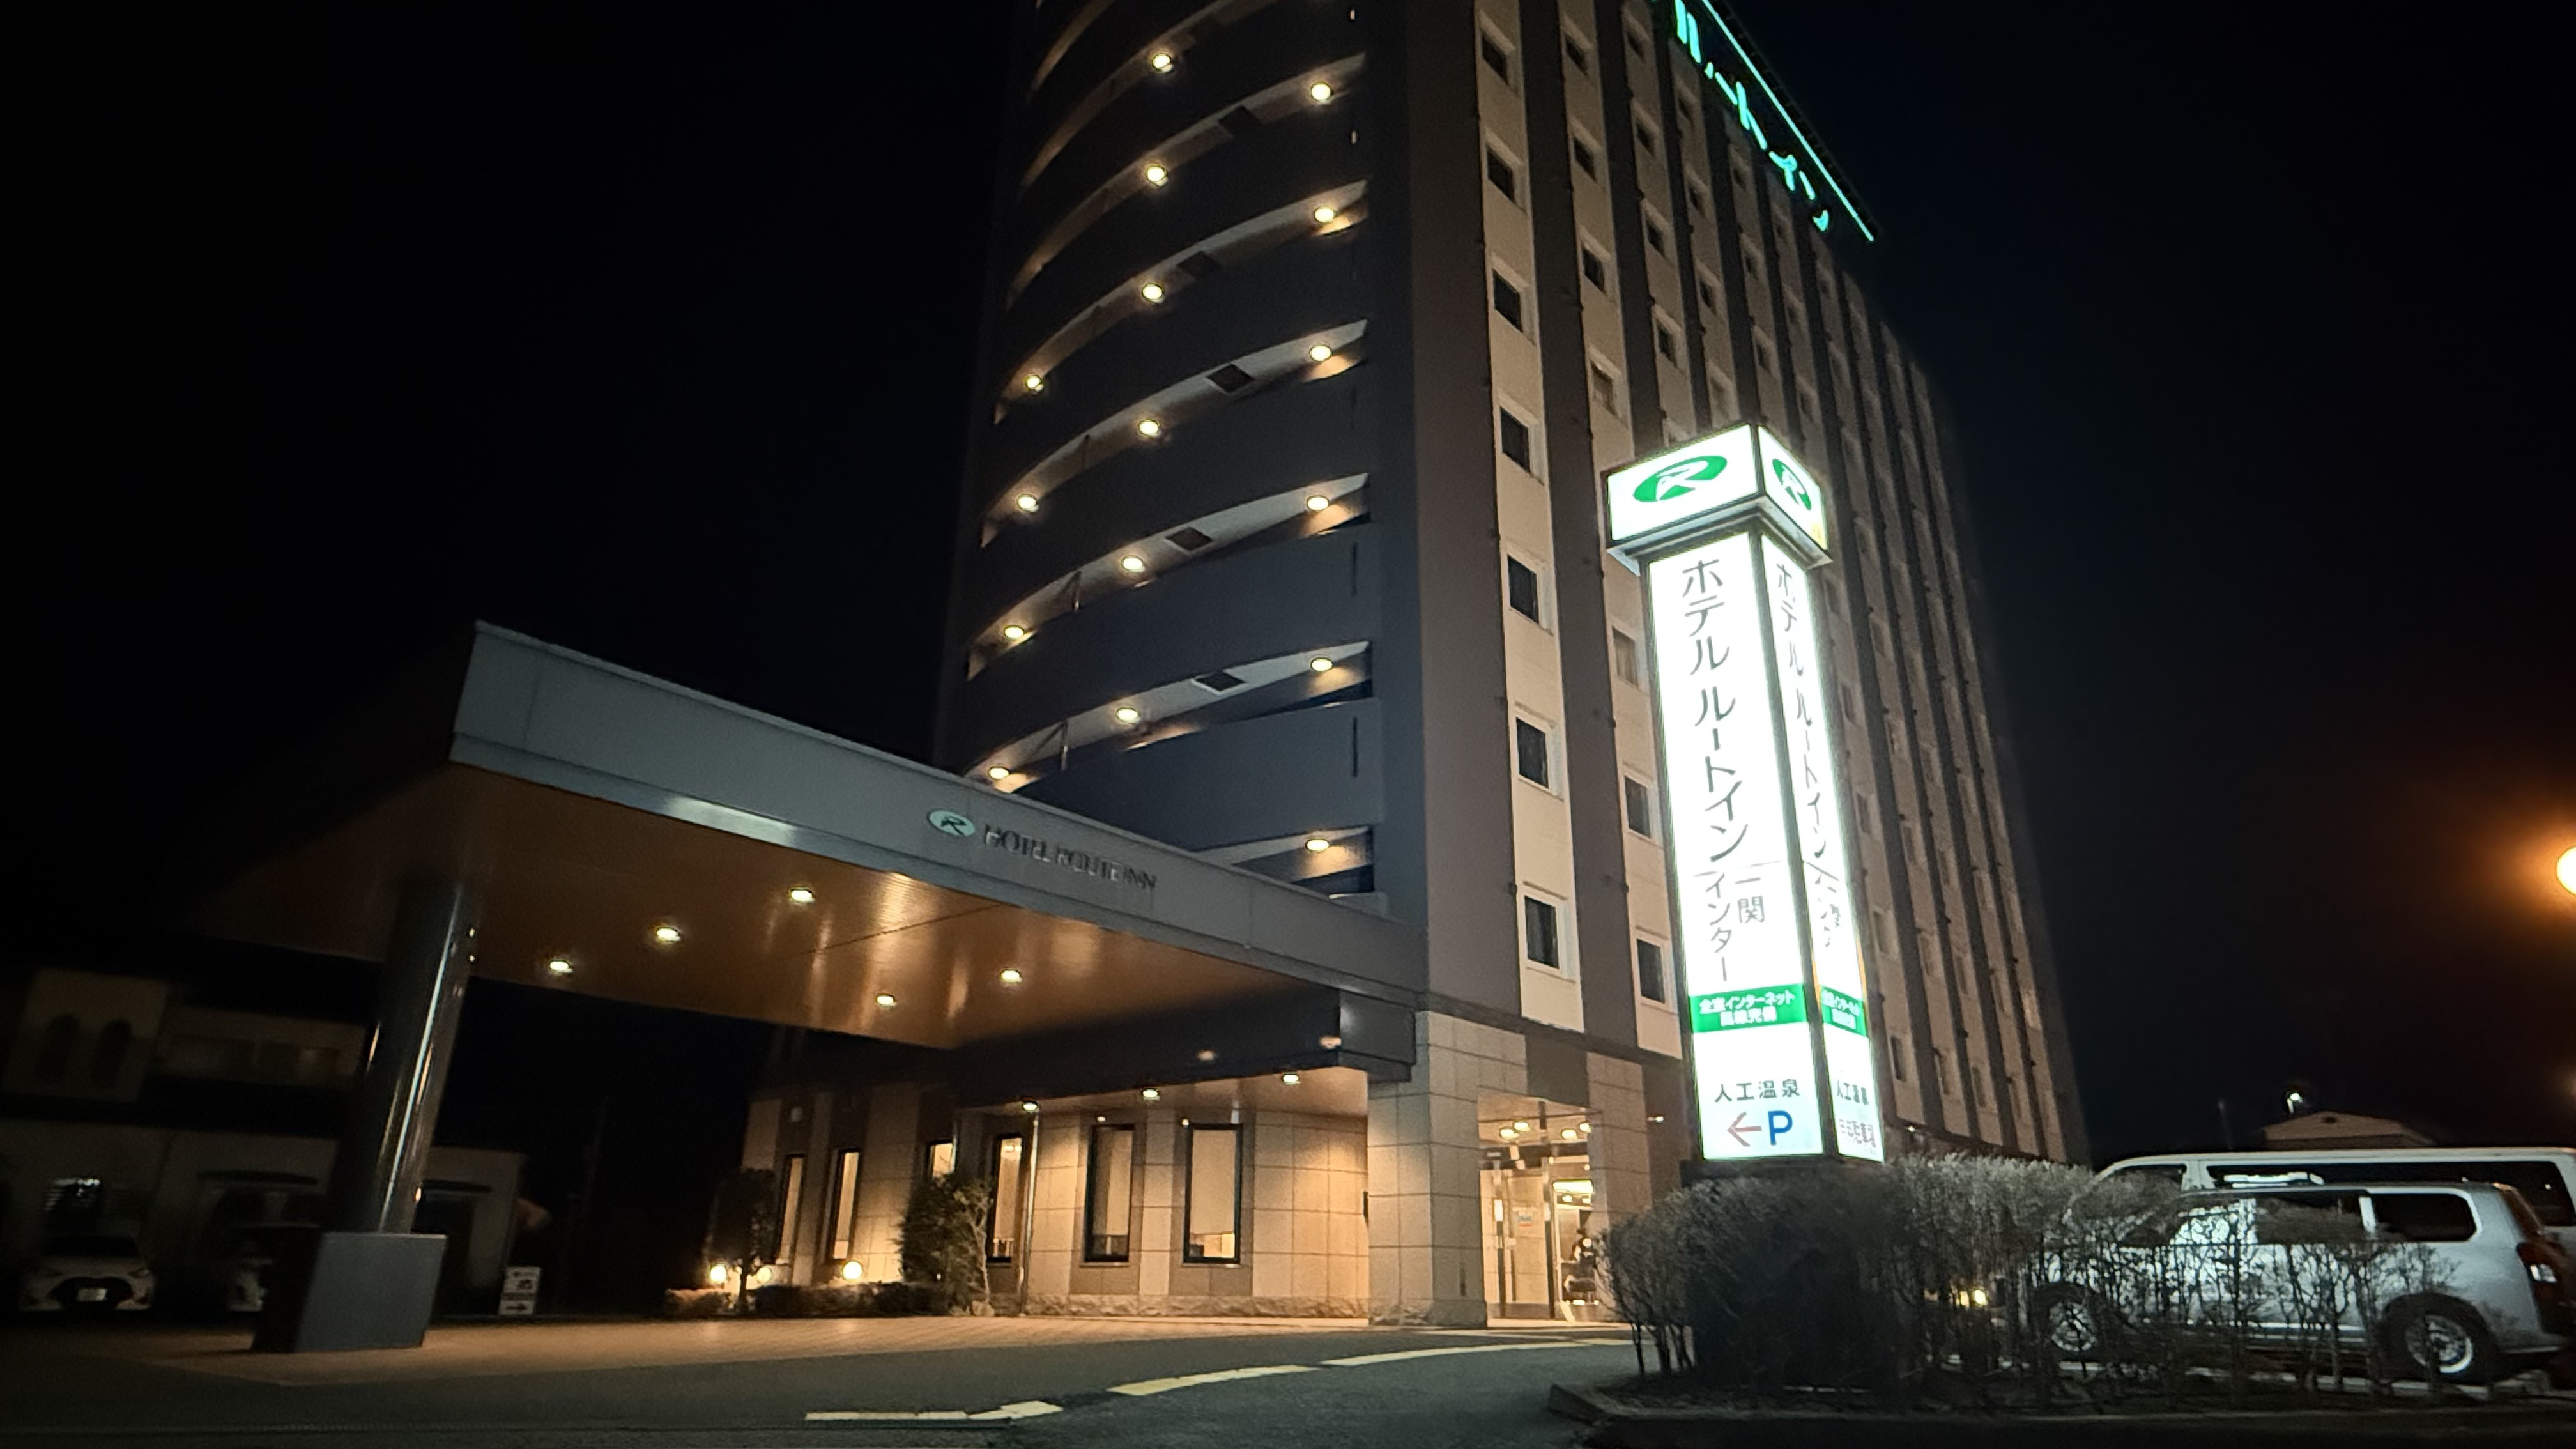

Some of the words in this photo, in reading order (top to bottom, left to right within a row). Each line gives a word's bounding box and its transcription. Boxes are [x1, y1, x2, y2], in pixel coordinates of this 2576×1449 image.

[1735, 877, 1765, 923] 一関
[1705, 873, 1732, 981] インター
[1715, 1078, 1800, 1103] 人工温泉
[1768, 1110, 1793, 1146] P
